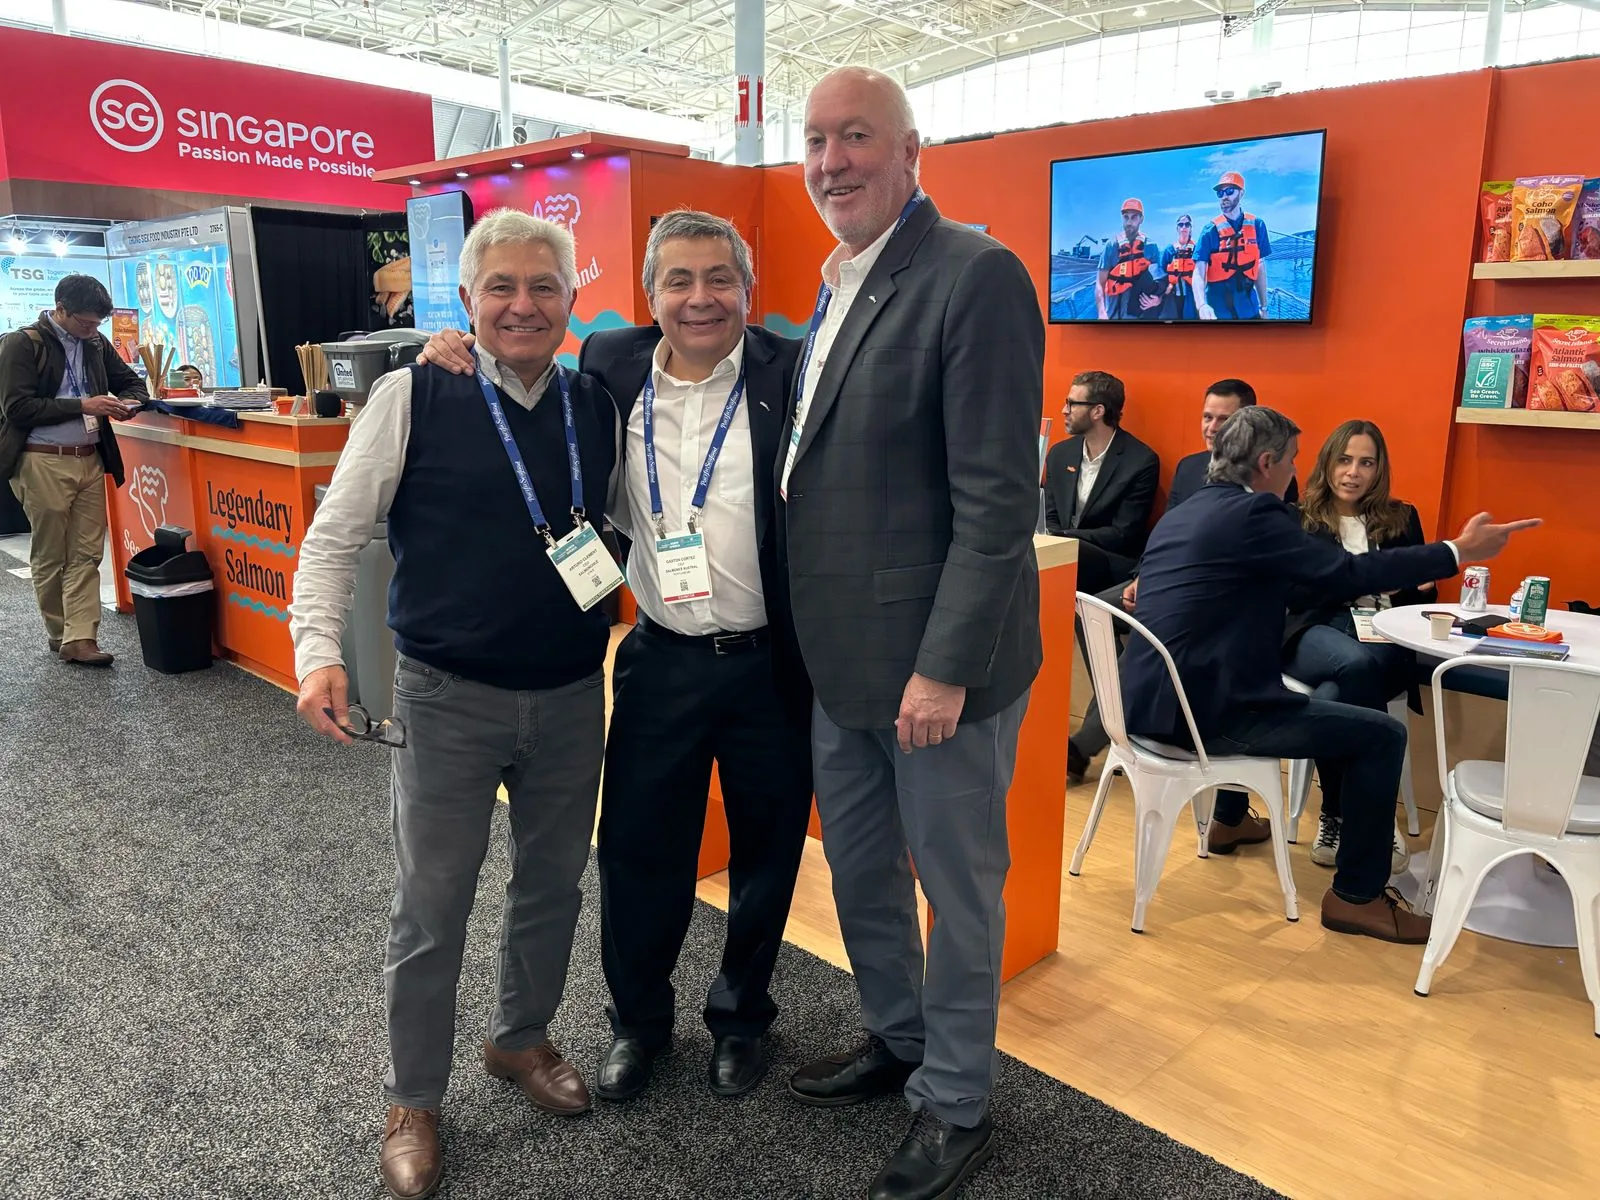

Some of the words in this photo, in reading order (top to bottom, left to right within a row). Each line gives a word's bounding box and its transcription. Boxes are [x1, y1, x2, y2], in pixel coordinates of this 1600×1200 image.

[101, 99, 154, 132] SG
[179, 142, 250, 164] Passion
[256, 151, 303, 170] Made
[308, 157, 376, 178] Possible
[150, 232, 160, 242] FOOD
[161, 229, 181, 240] INDUSTRY
[181, 227, 189, 238] PTE
[189, 226, 199, 236] LTD
[10, 268, 44, 280] TSG
[1552, 347, 1586, 355] Atlantic
[207, 481, 293, 543] Legendary
[225, 549, 287, 600] Salmon
